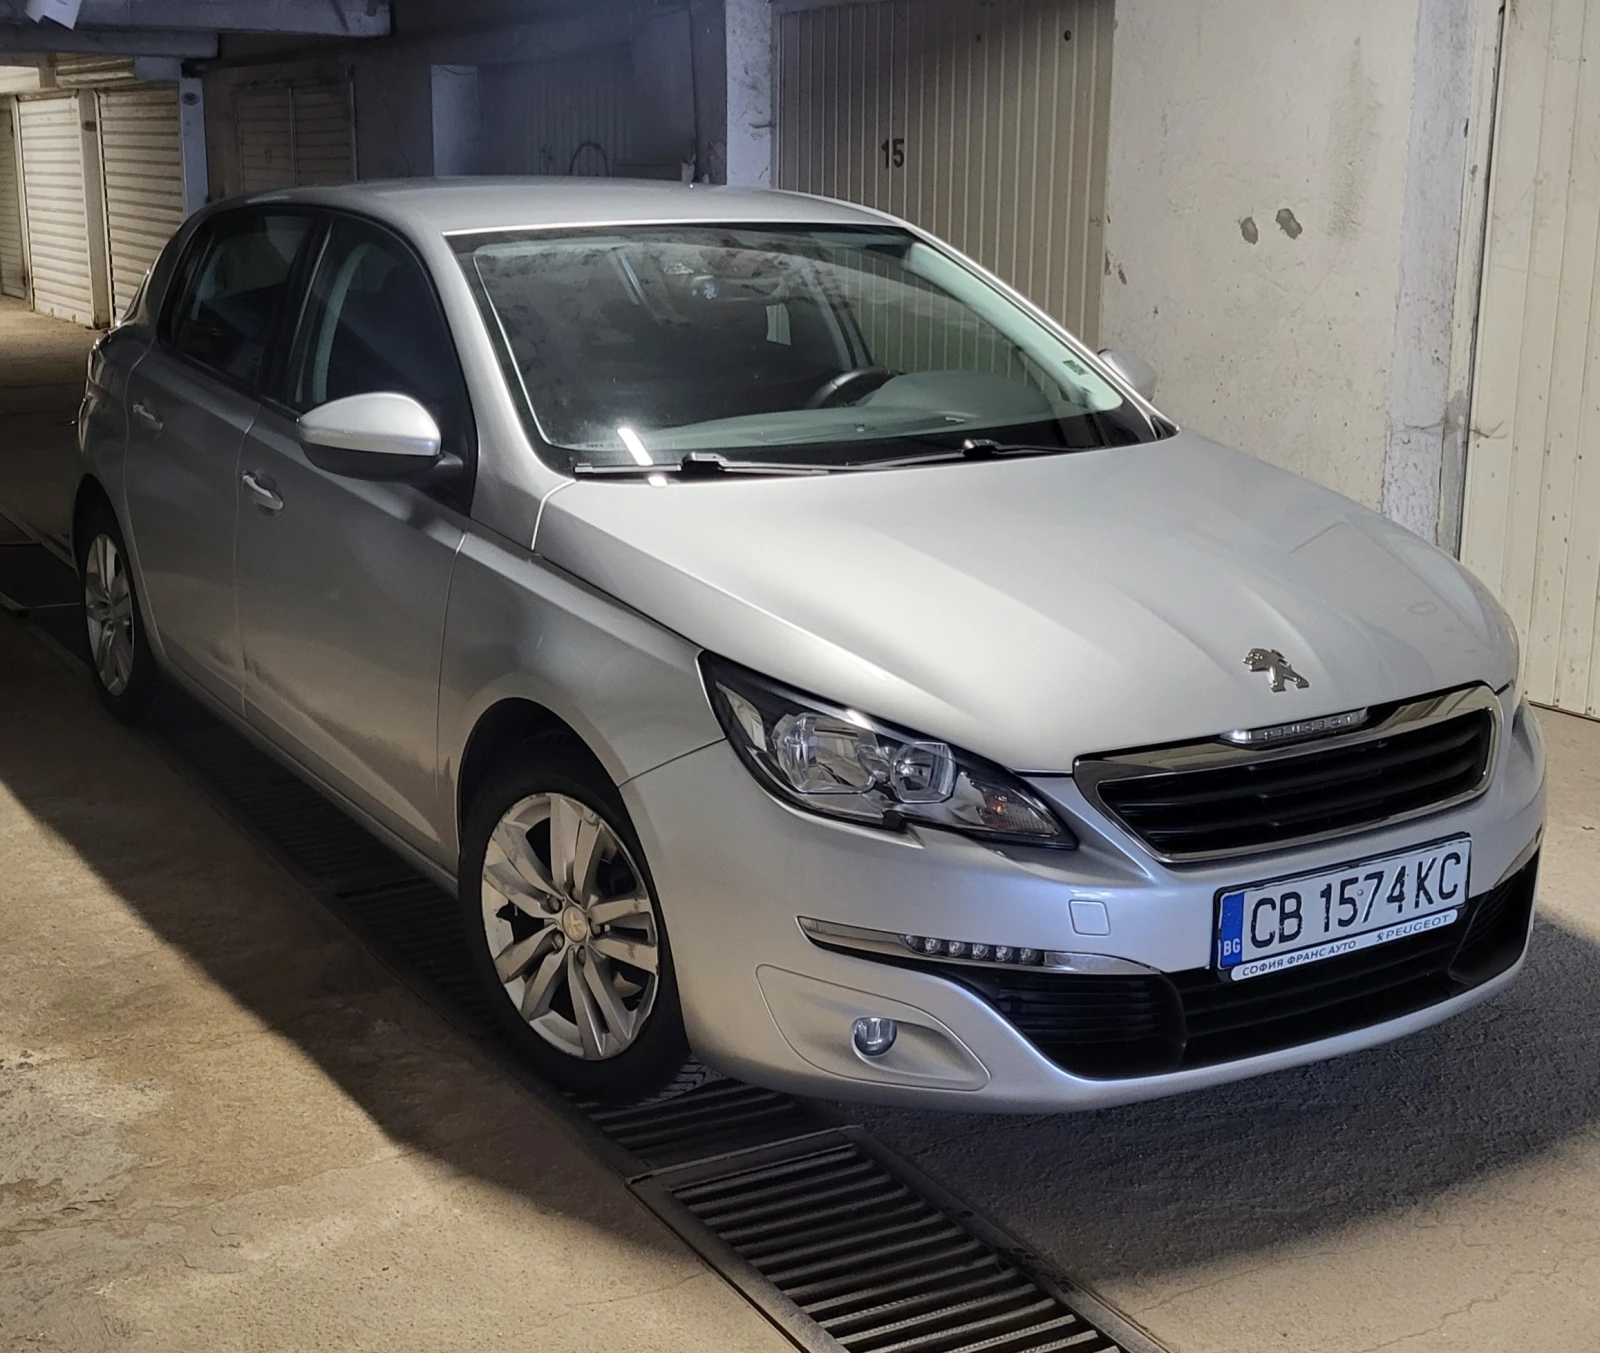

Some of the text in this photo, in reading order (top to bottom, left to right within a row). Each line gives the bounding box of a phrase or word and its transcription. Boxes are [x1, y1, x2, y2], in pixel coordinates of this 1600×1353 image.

[881, 138, 905, 169] 15
[1385, 914, 1450, 940] PEUGEOT
[1223, 938, 1241, 956] BG
[1242, 940, 1357, 976] СОФИЯ ФРАНС АУТО
